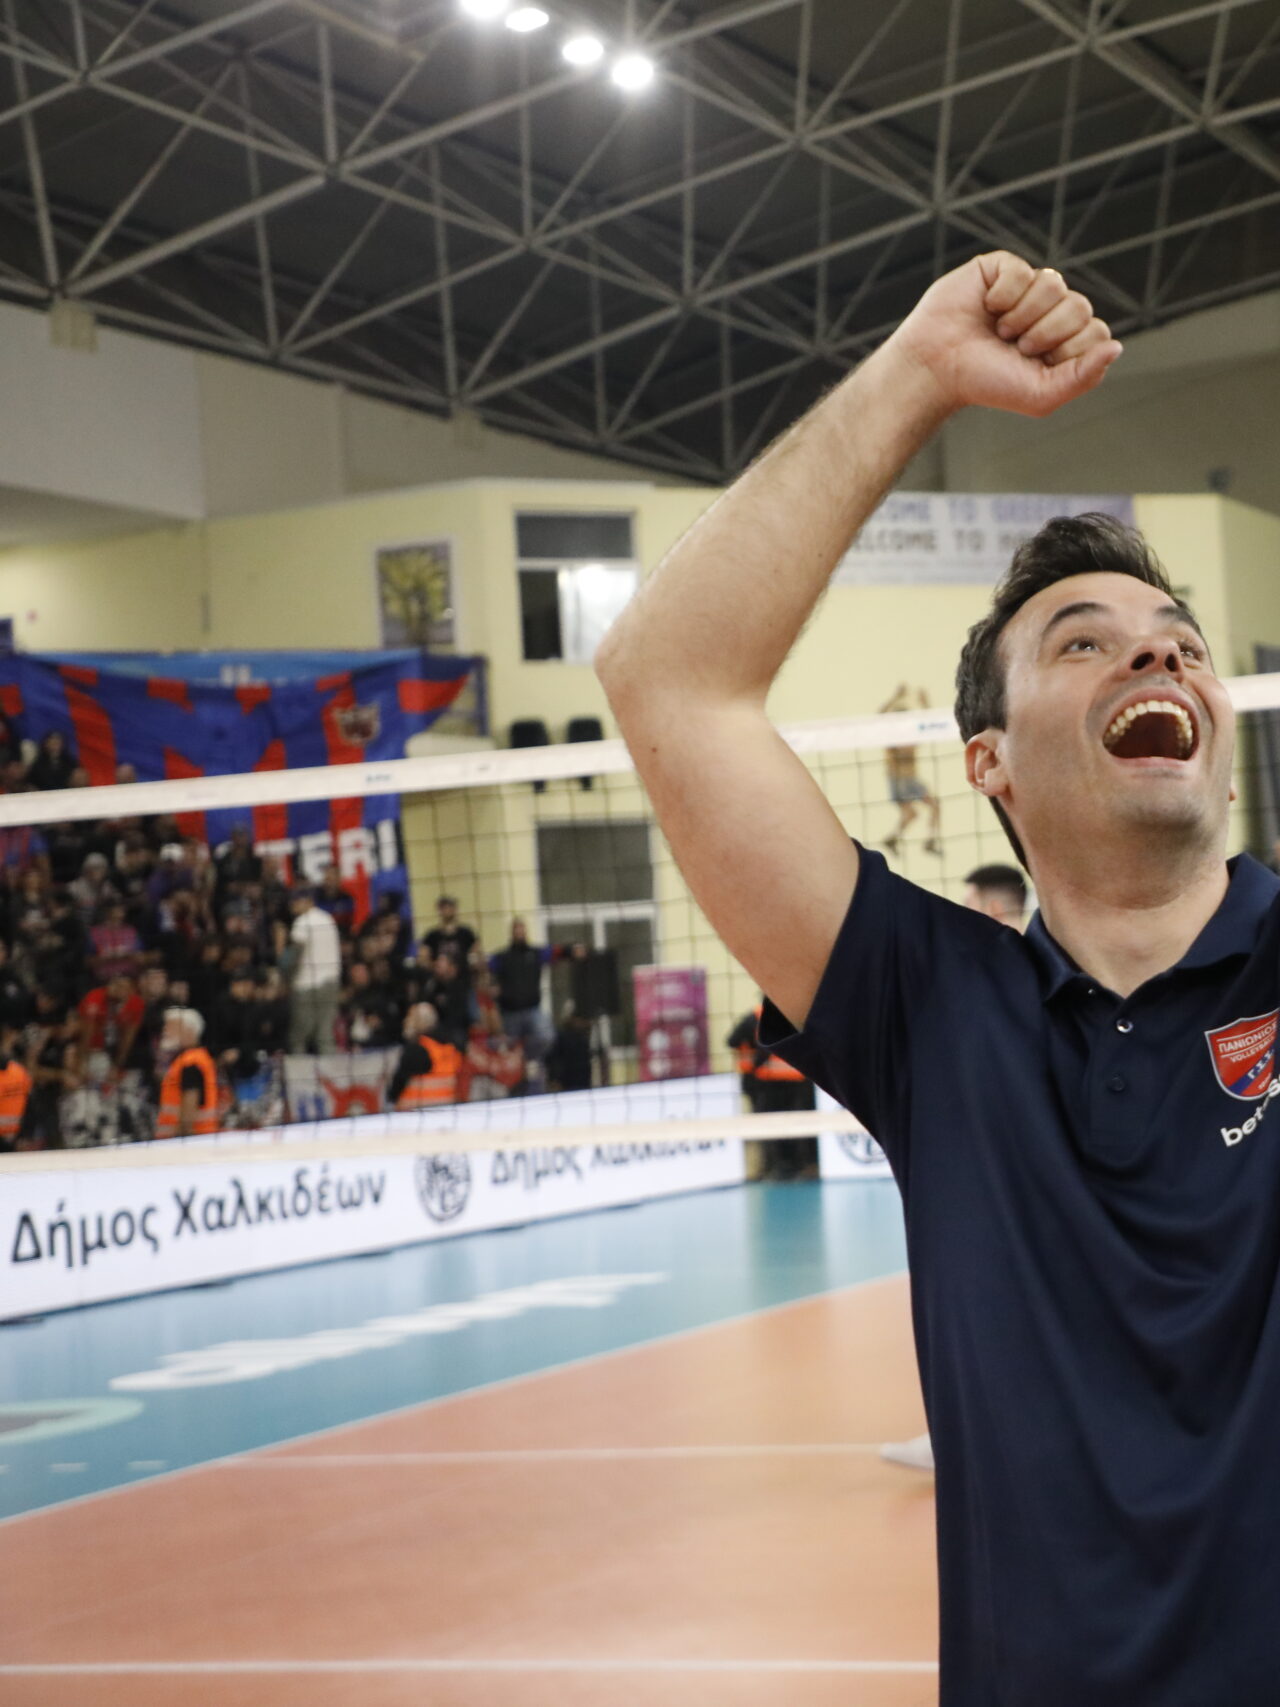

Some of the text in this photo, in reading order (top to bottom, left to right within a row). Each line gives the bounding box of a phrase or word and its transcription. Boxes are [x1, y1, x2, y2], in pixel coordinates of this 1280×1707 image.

[949, 496, 978, 523] TO
[954, 529, 985, 553] TO
[1218, 1020, 1278, 1054] ΠΑΝΙΩΝΙΟΣ
[11, 1163, 386, 1268] Δήμος Χαλκιδέων
